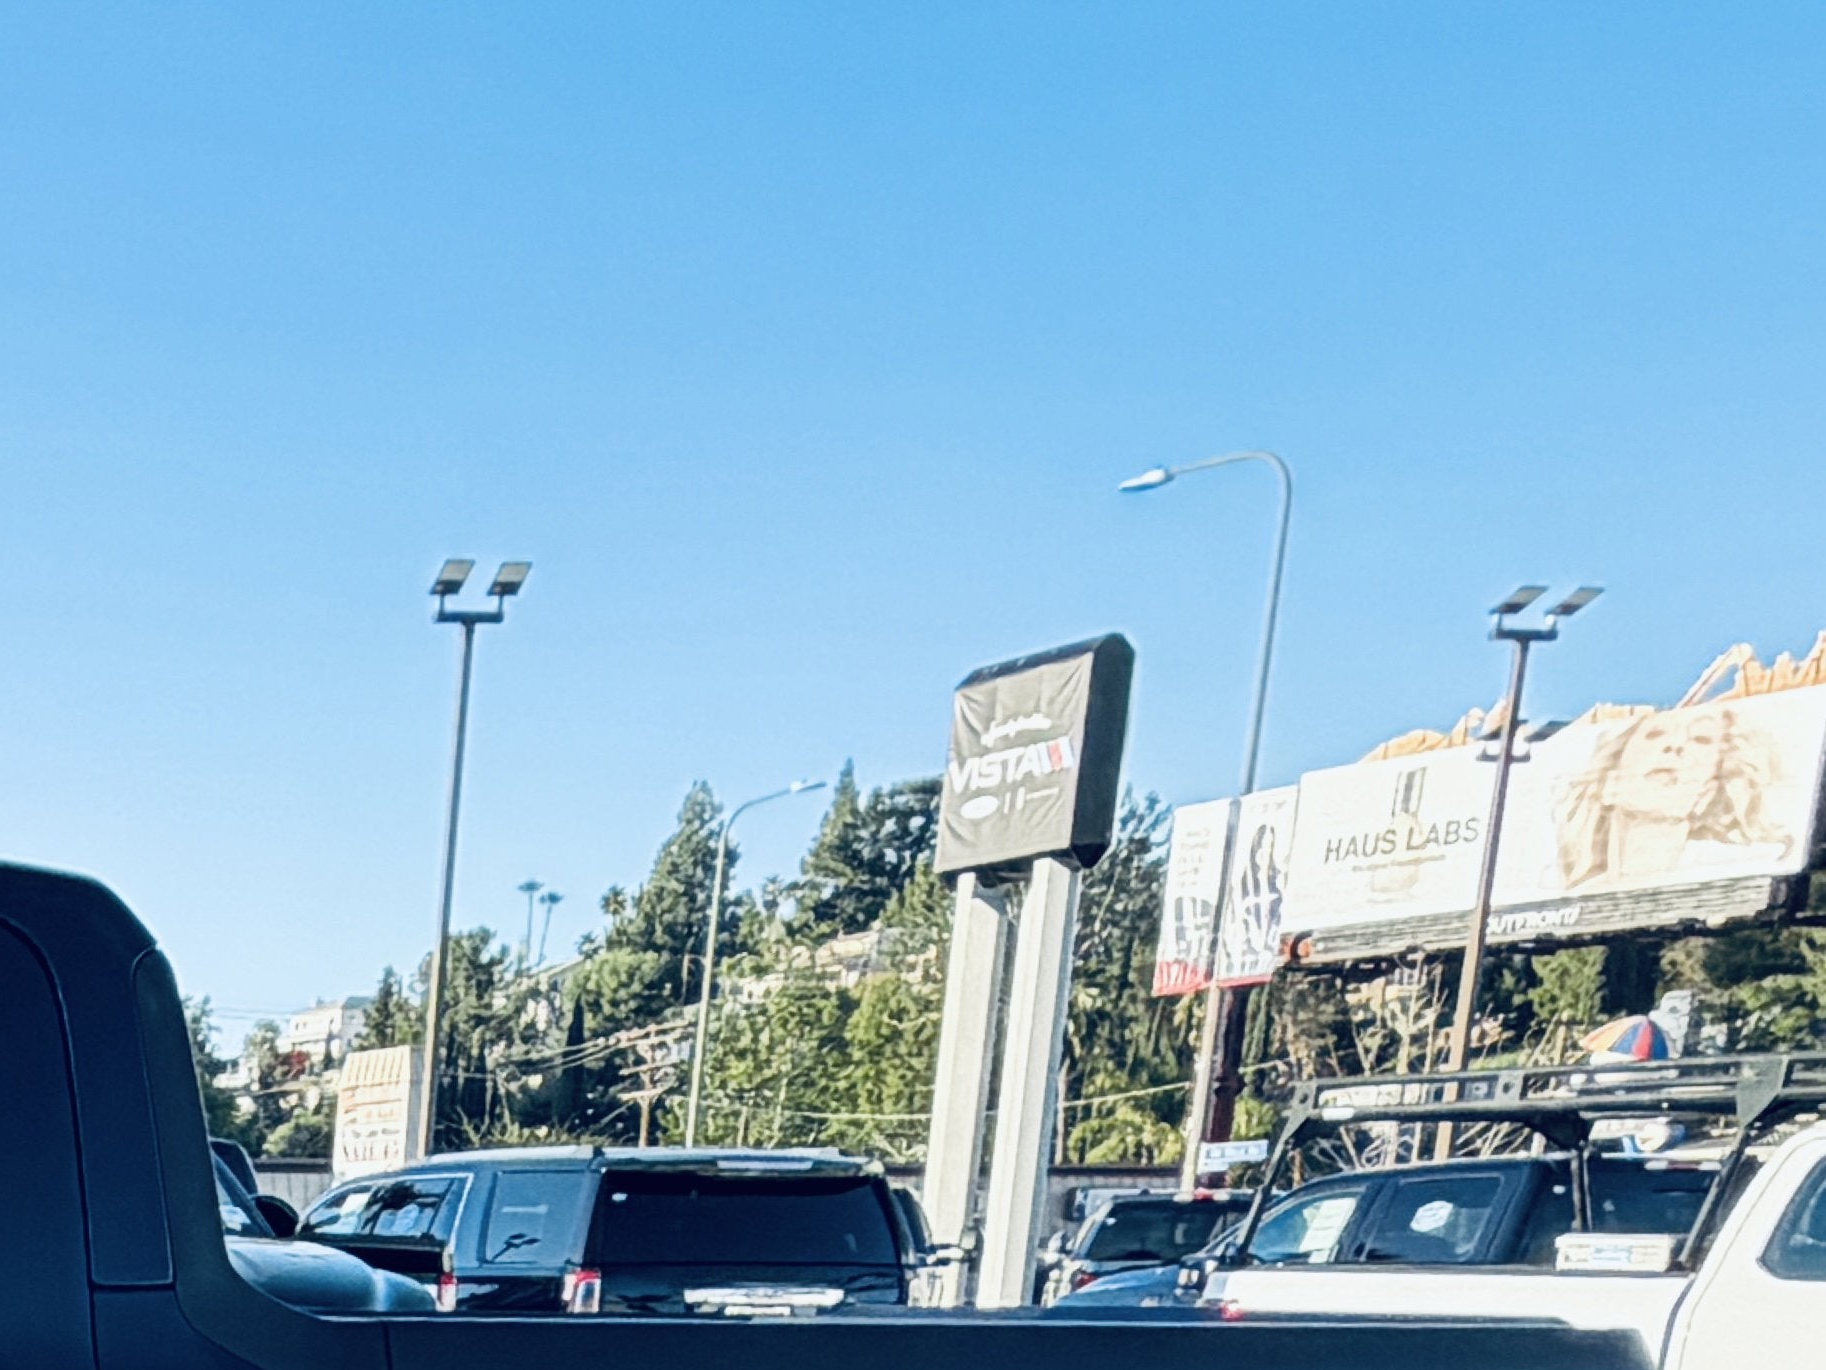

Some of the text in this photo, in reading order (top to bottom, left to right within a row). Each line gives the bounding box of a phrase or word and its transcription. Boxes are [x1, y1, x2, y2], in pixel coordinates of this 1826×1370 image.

[949, 743, 1041, 794] VISTA
[1324, 828, 1397, 864] HAUS
[1406, 817, 1481, 851] LABS
